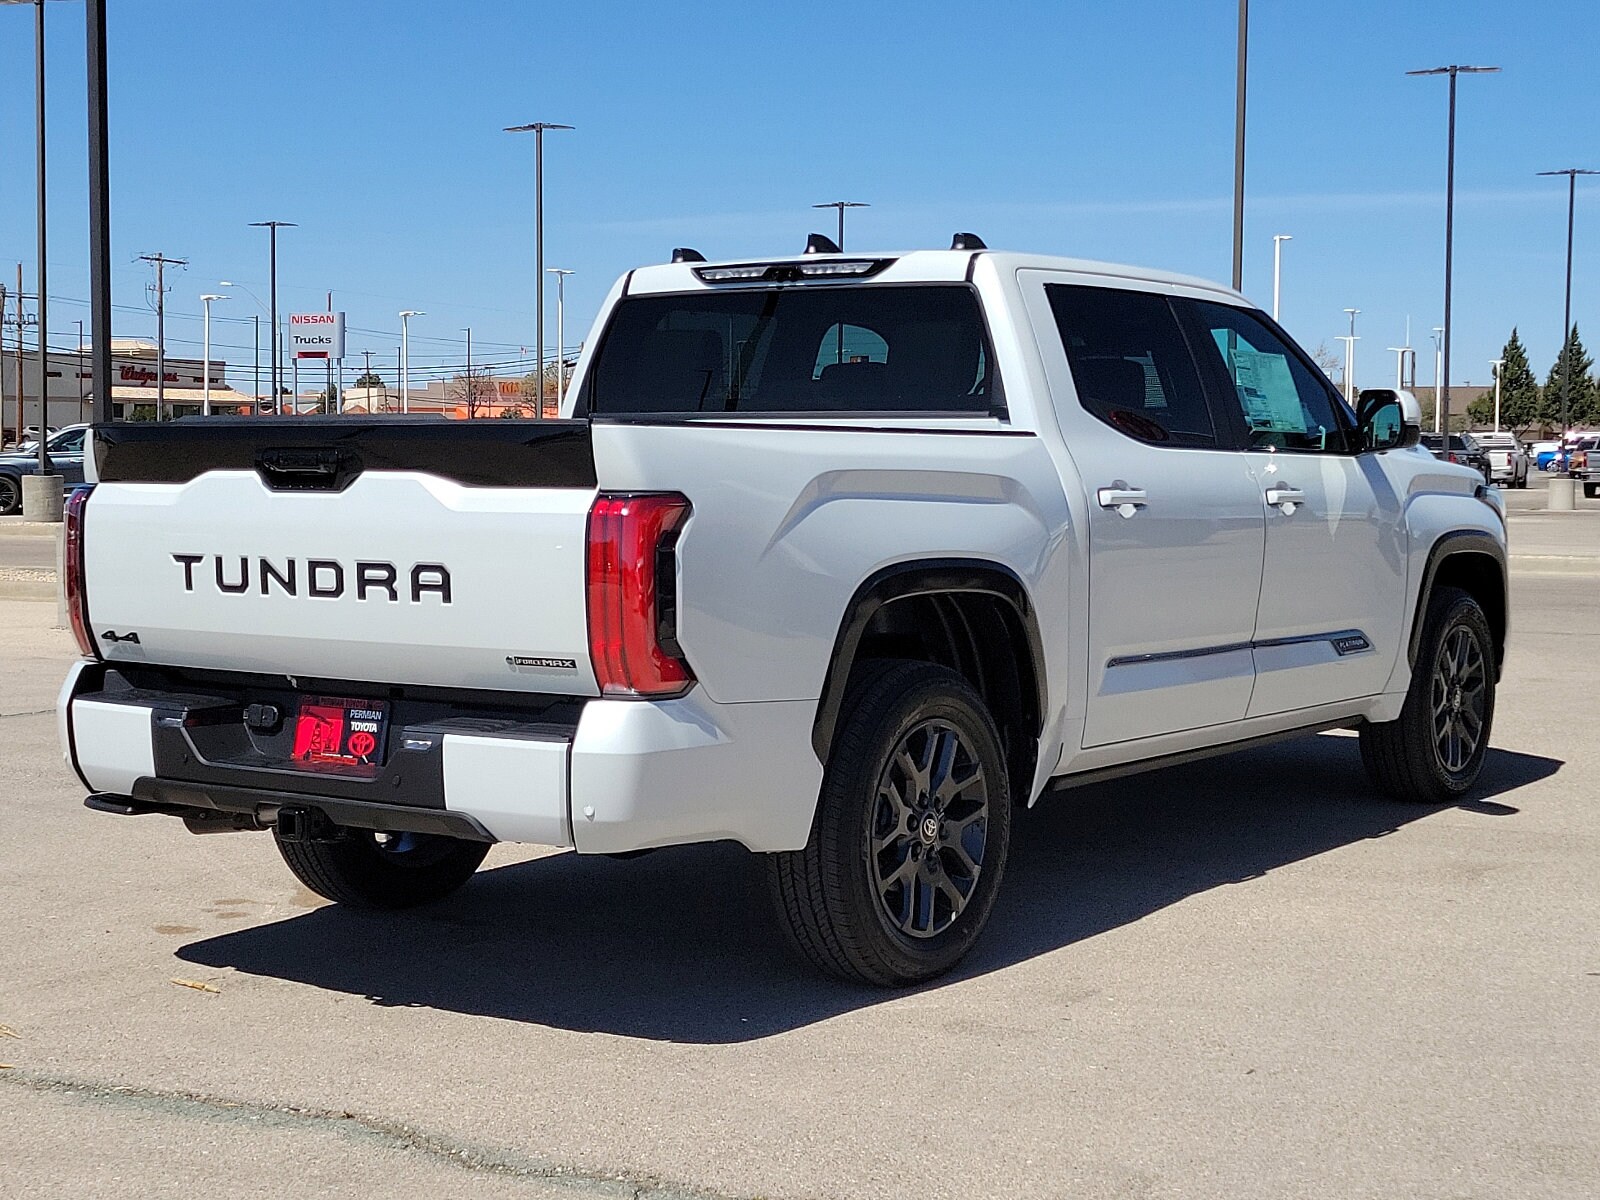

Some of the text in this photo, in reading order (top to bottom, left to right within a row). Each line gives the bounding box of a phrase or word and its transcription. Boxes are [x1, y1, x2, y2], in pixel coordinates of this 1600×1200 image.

[291, 315, 335, 324] NISSAN
[293, 335, 333, 344] Trucks
[119, 365, 180, 386] Walgrens
[170, 553, 453, 604] TUNDRA
[350, 709, 382, 720] PERMIAN
[350, 721, 378, 733] TOYOTA
